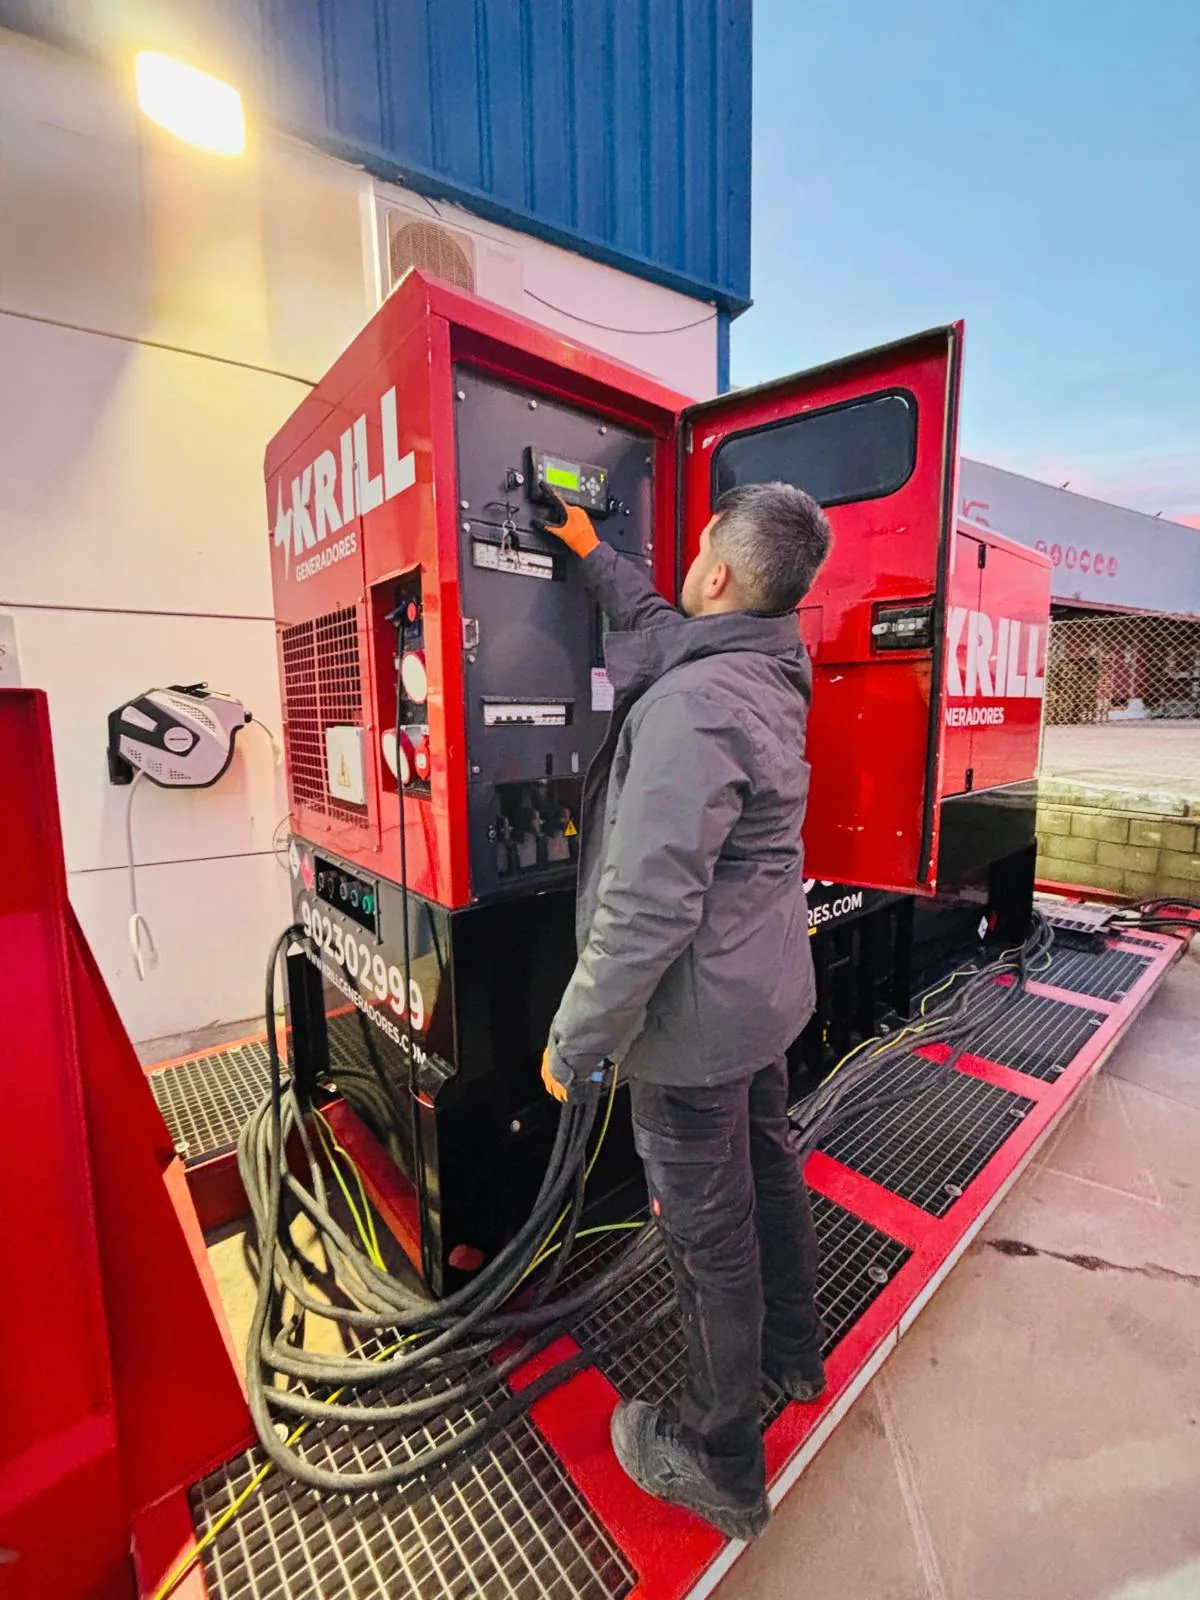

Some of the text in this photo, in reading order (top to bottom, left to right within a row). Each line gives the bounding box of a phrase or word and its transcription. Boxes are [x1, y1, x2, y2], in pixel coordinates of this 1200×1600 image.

[291, 385, 416, 556] KRILL
[296, 532, 358, 582] GENERADORES
[947, 605, 1045, 699] KRILL
[945, 706, 1005, 727] NERADORES
[807, 891, 863, 927] RES.COM
[302, 901, 424, 1031] 902302999
